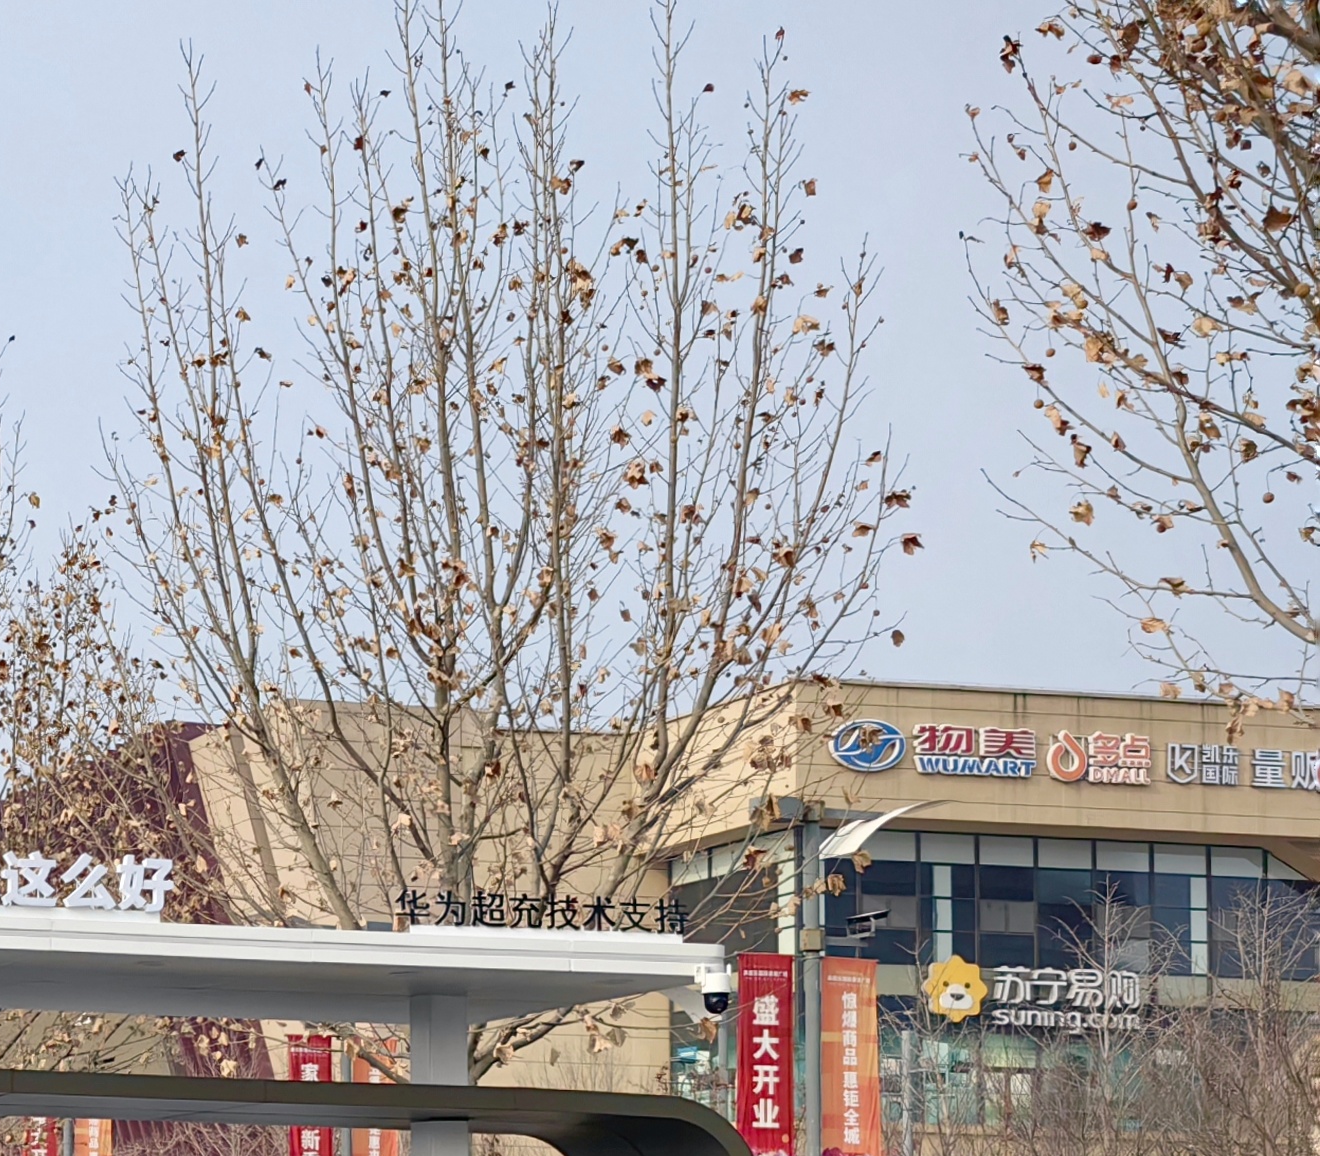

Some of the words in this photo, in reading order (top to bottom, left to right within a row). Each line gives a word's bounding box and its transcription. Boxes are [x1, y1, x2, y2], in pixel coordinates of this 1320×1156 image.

[913, 723, 1037, 758] 物美
[1088, 730, 1151, 767] 多点
[913, 755, 1037, 778] WUMART
[1087, 766, 1150, 786] DMALL
[394, 889, 690, 934] 华为超充技术支持
[992, 965, 1140, 1009] 苏宁易购
[992, 1007, 1140, 1035] suning.com
[752, 995, 781, 1130] 盛大开业
